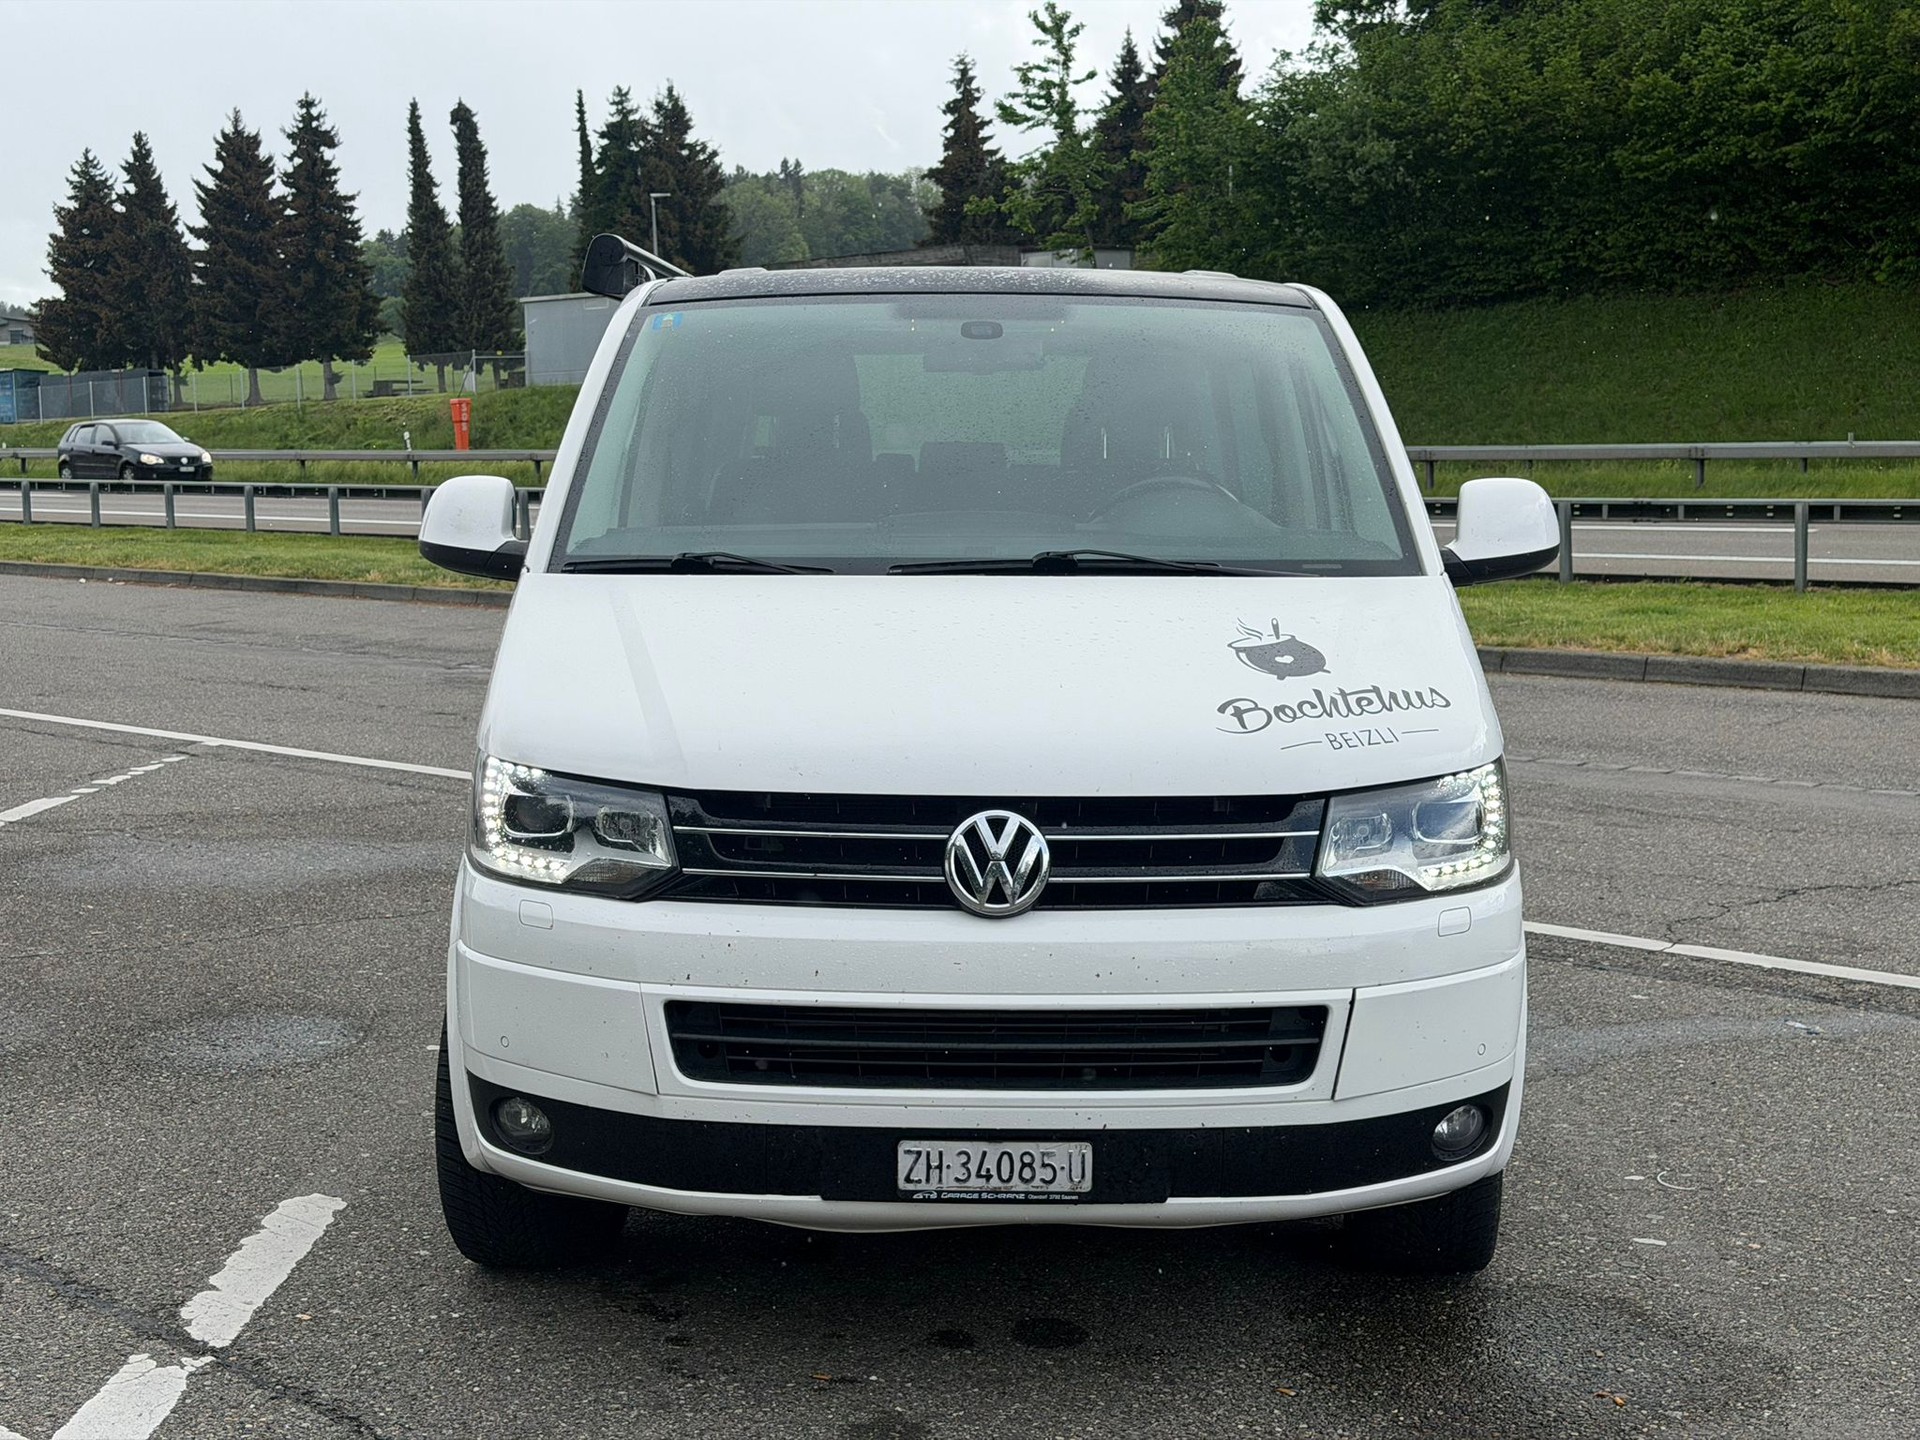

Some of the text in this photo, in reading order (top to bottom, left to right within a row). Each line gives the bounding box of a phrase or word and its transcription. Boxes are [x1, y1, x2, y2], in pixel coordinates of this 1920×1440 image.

[1325, 727, 1399, 750] BEIZLI
[950, 812, 1044, 911] VW
[940, 1191, 980, 1199] GARAGE
